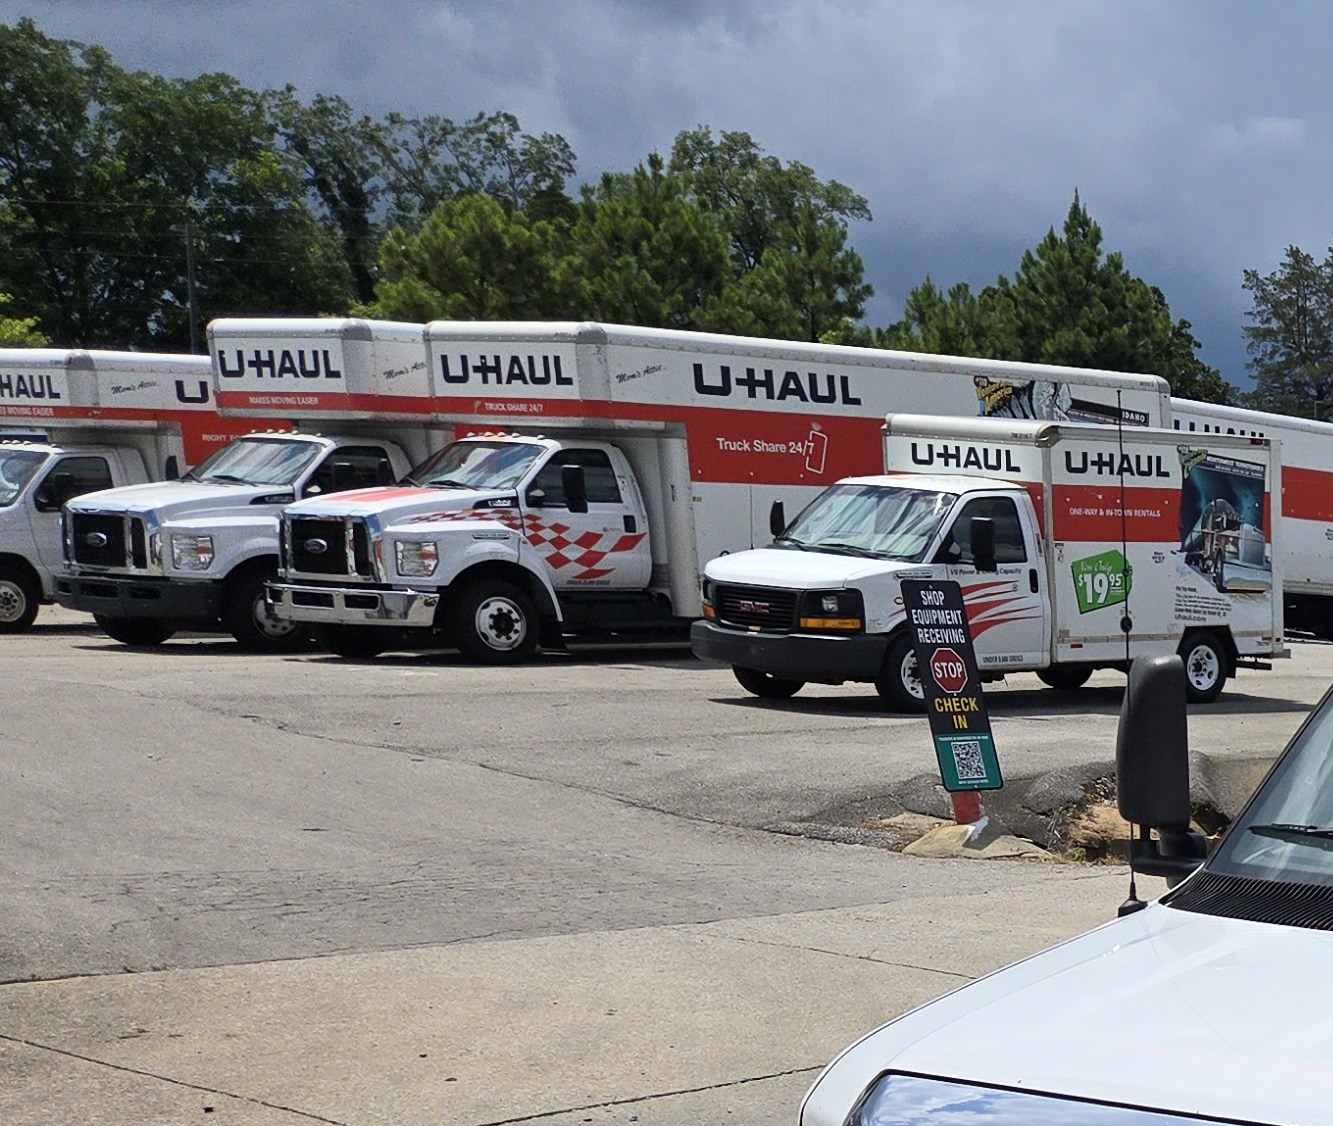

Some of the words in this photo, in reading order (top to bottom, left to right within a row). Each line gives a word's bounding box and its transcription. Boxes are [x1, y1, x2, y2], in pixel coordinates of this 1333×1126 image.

[218, 349, 342, 379] U-HAUL
[440, 354, 574, 386] U-HAUL
[692, 362, 862, 406] U-HAUL
[484, 402, 507, 412] TRUCK
[507, 403, 528, 413] SHARE
[1122, 411, 1146, 423] IDAHO
[202, 433, 227, 442] RIGHT
[716, 437, 751, 451] Truck
[753, 439, 787, 453] Share
[788, 439, 815, 456] 24/7
[911, 442, 1021, 473] U-HAUL
[1064, 450, 1171, 478] U-HAUL
[1069, 507, 1098, 516] ONE-WAY
[1134, 509, 1161, 518] RENTALS
[959, 568, 975, 576] Power
[920, 590, 945, 606] SHOP
[739, 600, 770, 613] GMC
[911, 609, 963, 625] EQUIPMENT
[917, 628, 966, 644] RECEIVING
[934, 661, 963, 679] STOP
[934, 698, 979, 713] CHECK
[953, 715, 968, 729] IN
